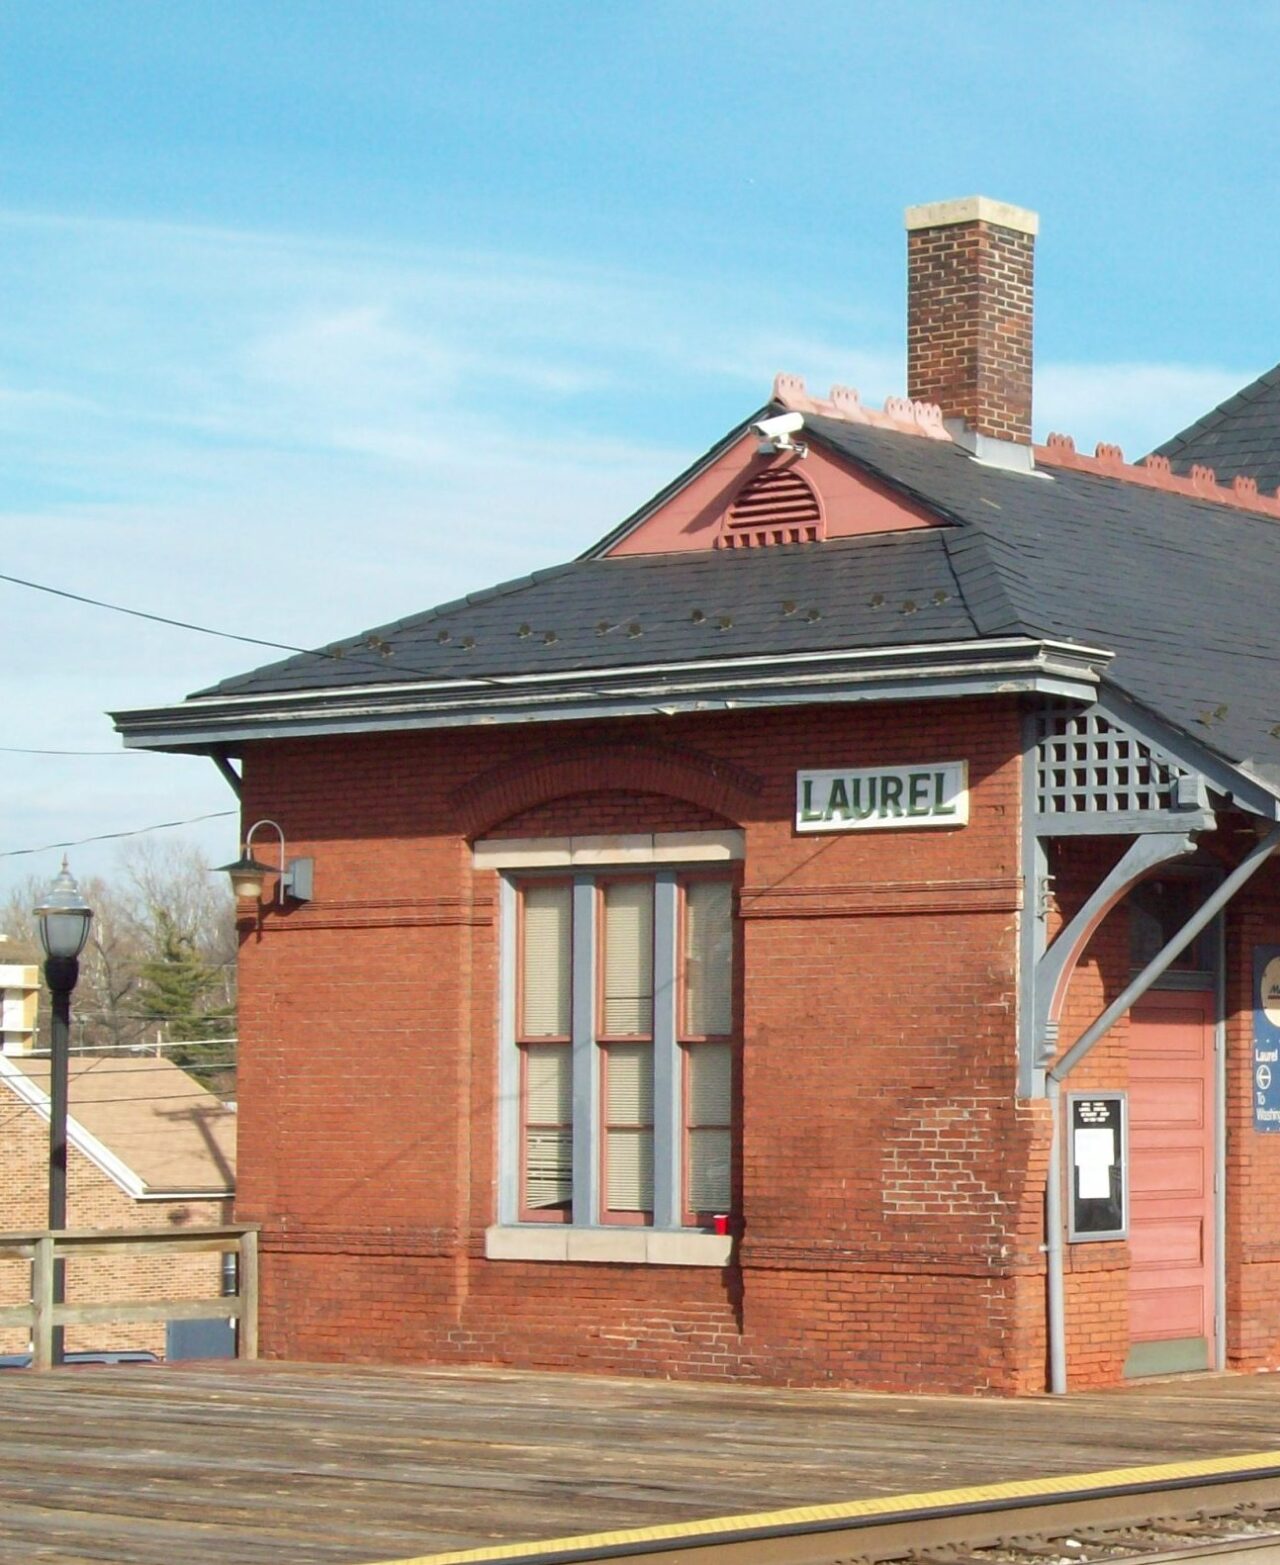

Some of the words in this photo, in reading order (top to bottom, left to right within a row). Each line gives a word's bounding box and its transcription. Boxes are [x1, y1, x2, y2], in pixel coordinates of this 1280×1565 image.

[800, 773, 956, 822] LAUREL
[1255, 1048, 1279, 1062] Laurel
[1256, 1091, 1266, 1105] To
